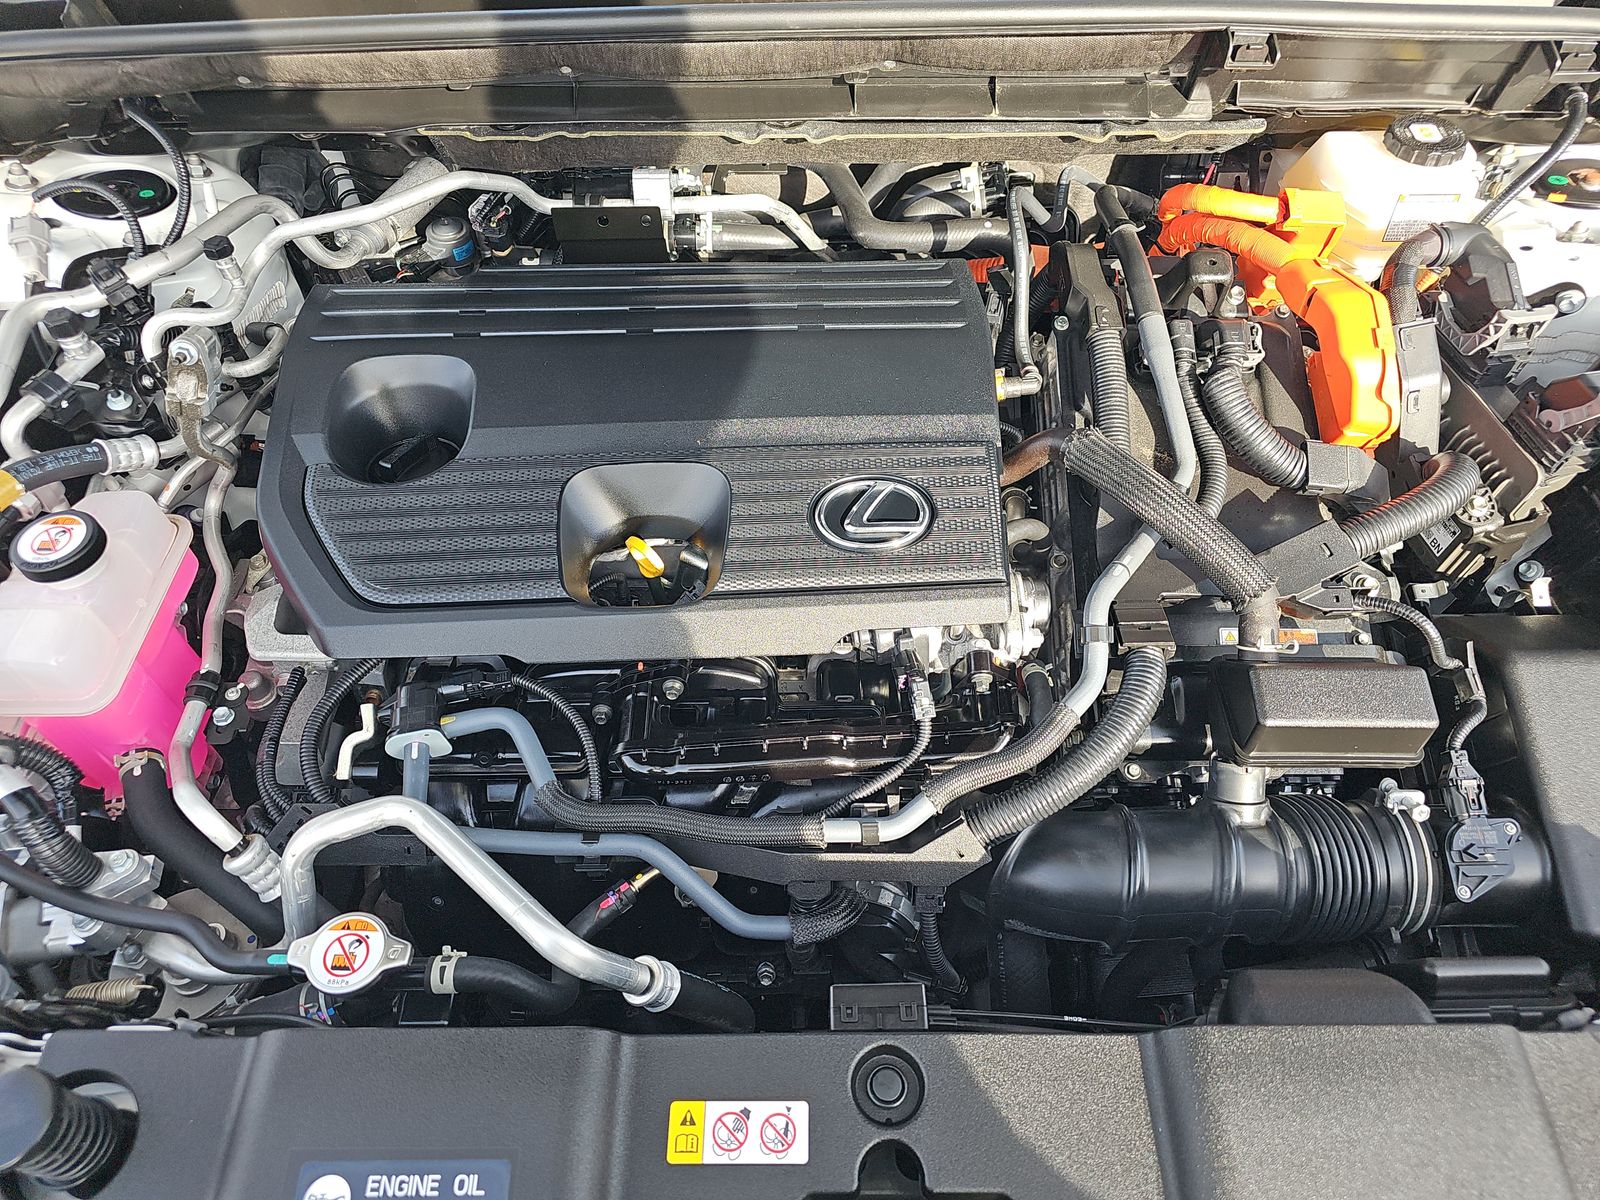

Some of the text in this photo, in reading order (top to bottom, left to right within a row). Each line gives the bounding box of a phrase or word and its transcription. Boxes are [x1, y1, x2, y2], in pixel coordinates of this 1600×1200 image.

[1429, 537, 1444, 554] BN
[364, 1173, 486, 1198] ENGINE OIL
